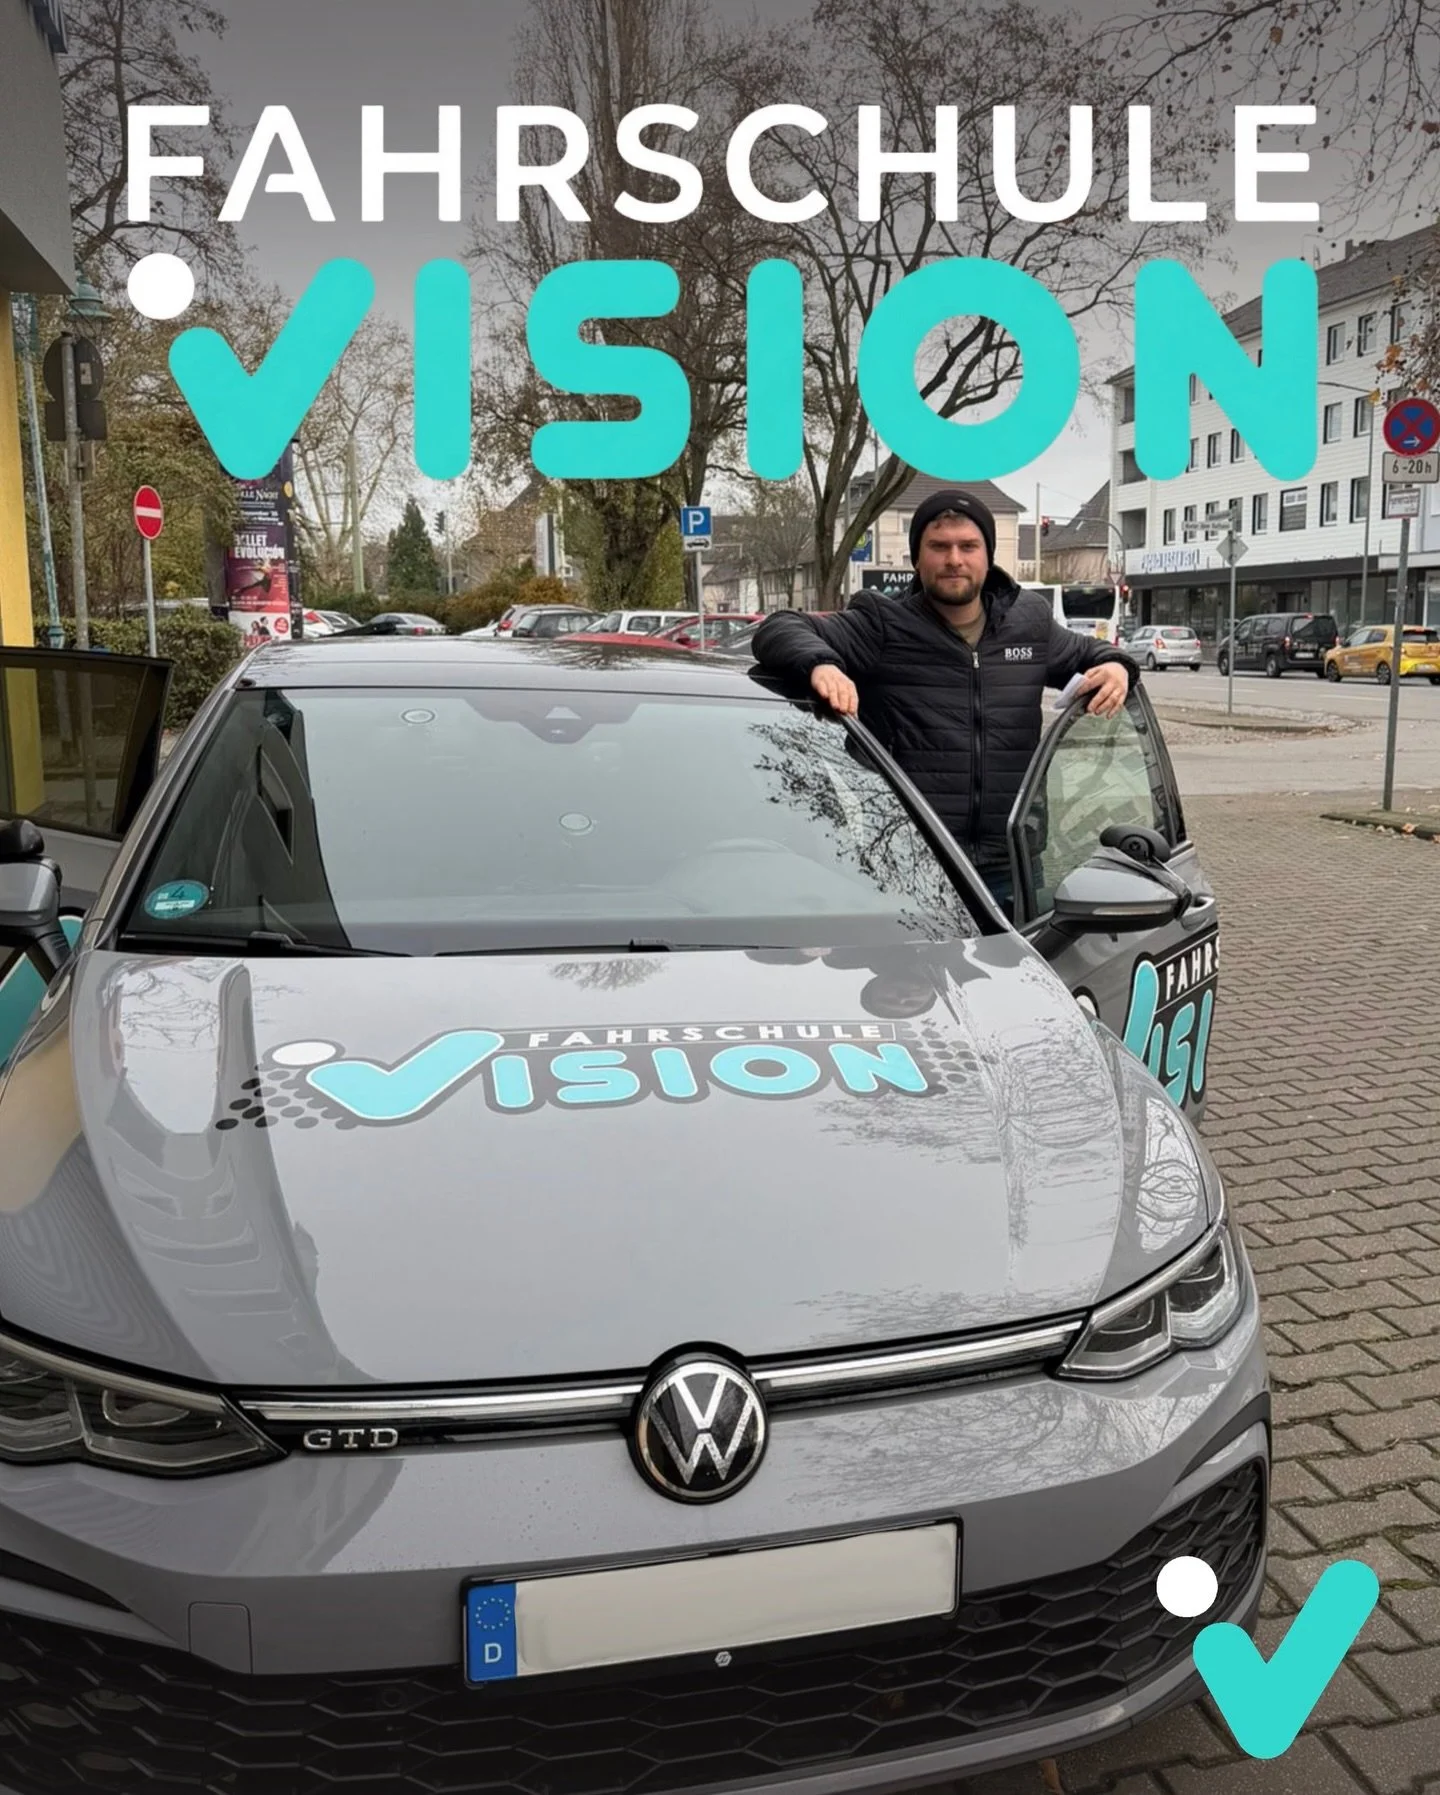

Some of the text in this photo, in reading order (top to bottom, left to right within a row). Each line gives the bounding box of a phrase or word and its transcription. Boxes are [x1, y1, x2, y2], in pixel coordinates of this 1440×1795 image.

[688, 510, 705, 534] P
[1004, 646, 1033, 658] BOSS
[528, 1024, 882, 1049] FAHRSCHULE
[306, 1029, 929, 1120] VISION
[302, 1427, 400, 1451] GTD
[484, 1642, 502, 1663] D
